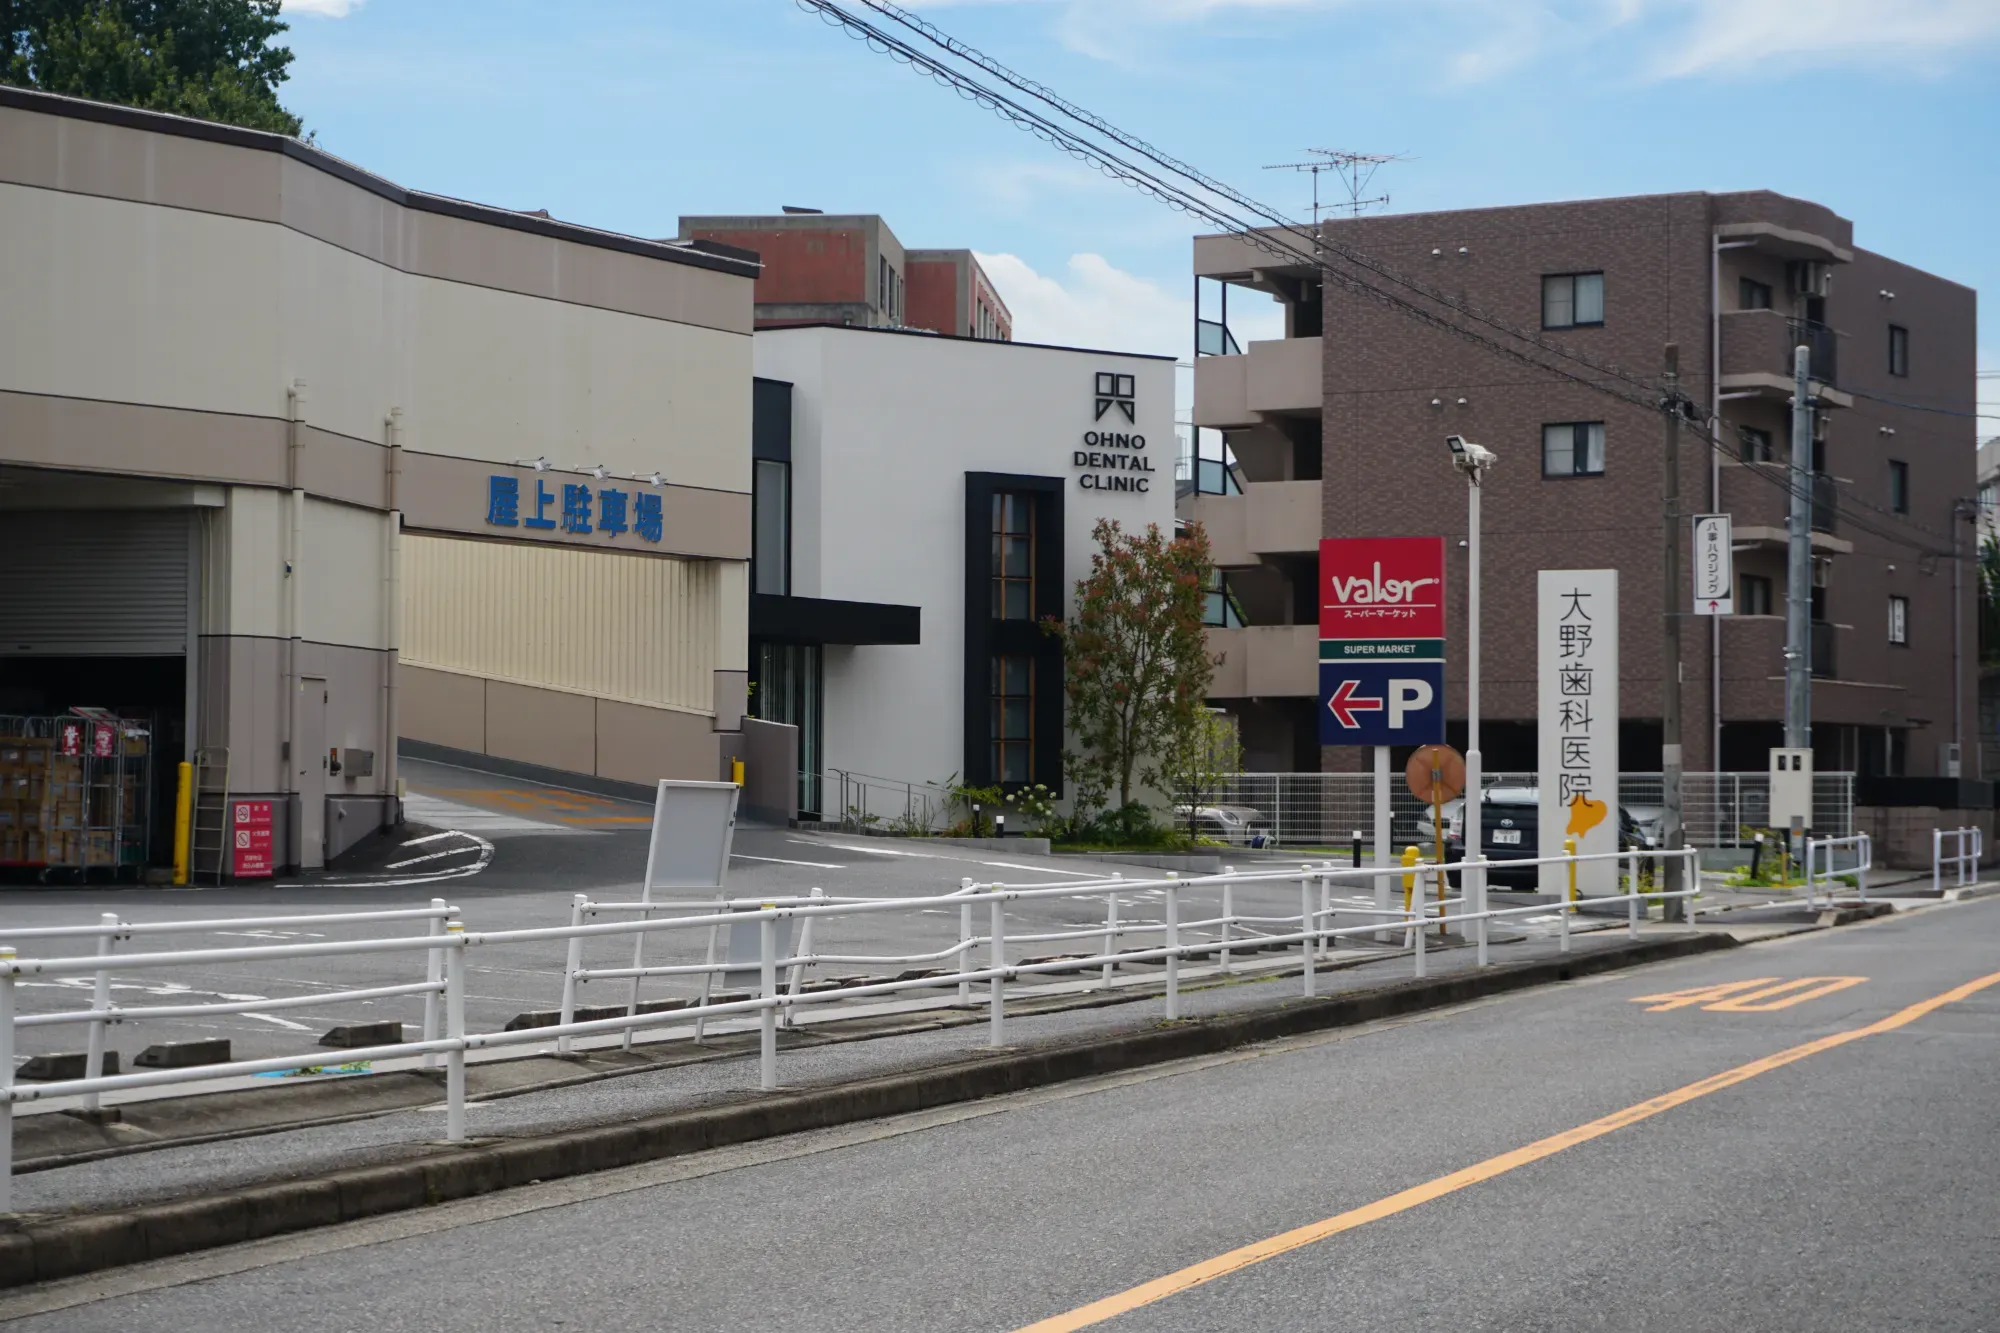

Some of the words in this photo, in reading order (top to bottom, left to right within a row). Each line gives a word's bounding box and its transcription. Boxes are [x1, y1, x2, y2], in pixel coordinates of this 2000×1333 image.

[1084, 431, 1146, 450] OHNO
[1073, 451, 1155, 472] DENTAL
[1079, 473, 1149, 493] CLINIC
[485, 475, 663, 543] 屋上駐車場
[1344, 609, 1417, 619] スーパーマーケット
[1344, 644, 1375, 655] SUPER
[1377, 644, 1416, 654] MARKET
[1388, 679, 1433, 729] P
[1558, 587, 1594, 808] 大野歯科医院
